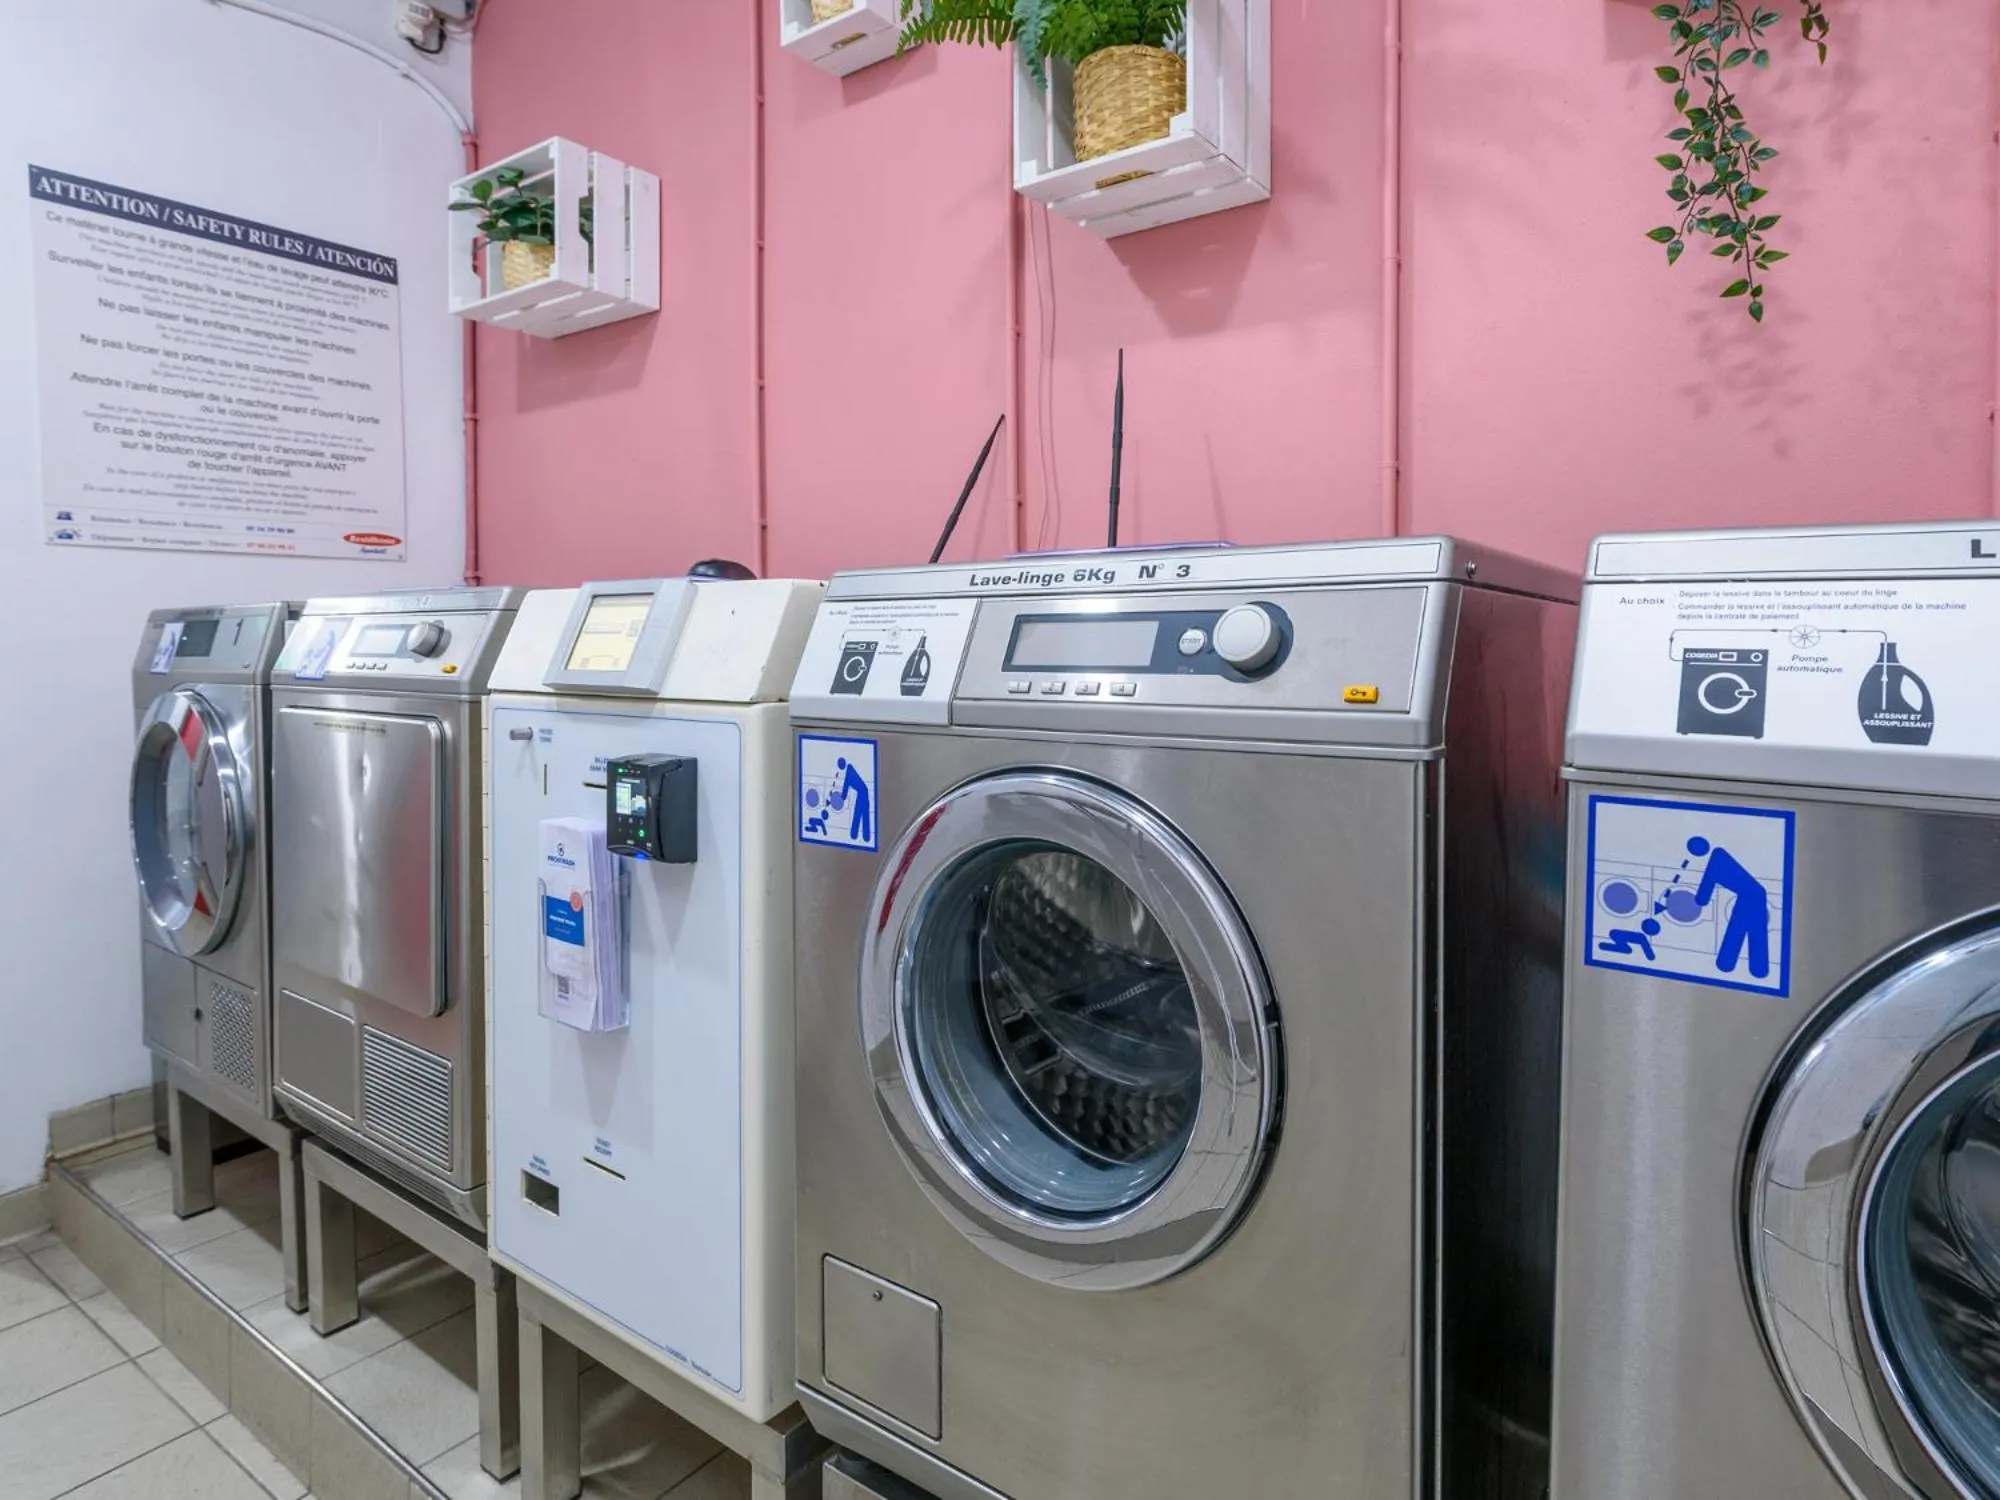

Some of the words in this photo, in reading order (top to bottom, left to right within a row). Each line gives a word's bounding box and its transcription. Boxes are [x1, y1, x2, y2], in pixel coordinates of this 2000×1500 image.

[36, 175, 159, 220] ATTENTION
[173, 208, 245, 240] SAFETY
[248, 227, 305, 255] RULES
[315, 245, 394, 278] ATENCIÓN
[93, 422, 110, 433] En
[113, 427, 133, 436] cas
[137, 429, 151, 438] de
[155, 443, 194, 455] bouton
[314, 461, 346, 472] AVANT
[969, 571, 1065, 587] Lave-linge
[1073, 567, 1116, 584] 6Kg
[1176, 564, 1191, 578] 3
[1619, 597, 1634, 605] Au
[1637, 597, 1665, 605] choix
[1791, 655, 1828, 663] Pompe
[1777, 665, 1843, 674] automatique
[1863, 719, 1934, 728] ASSOUPLISSANT
